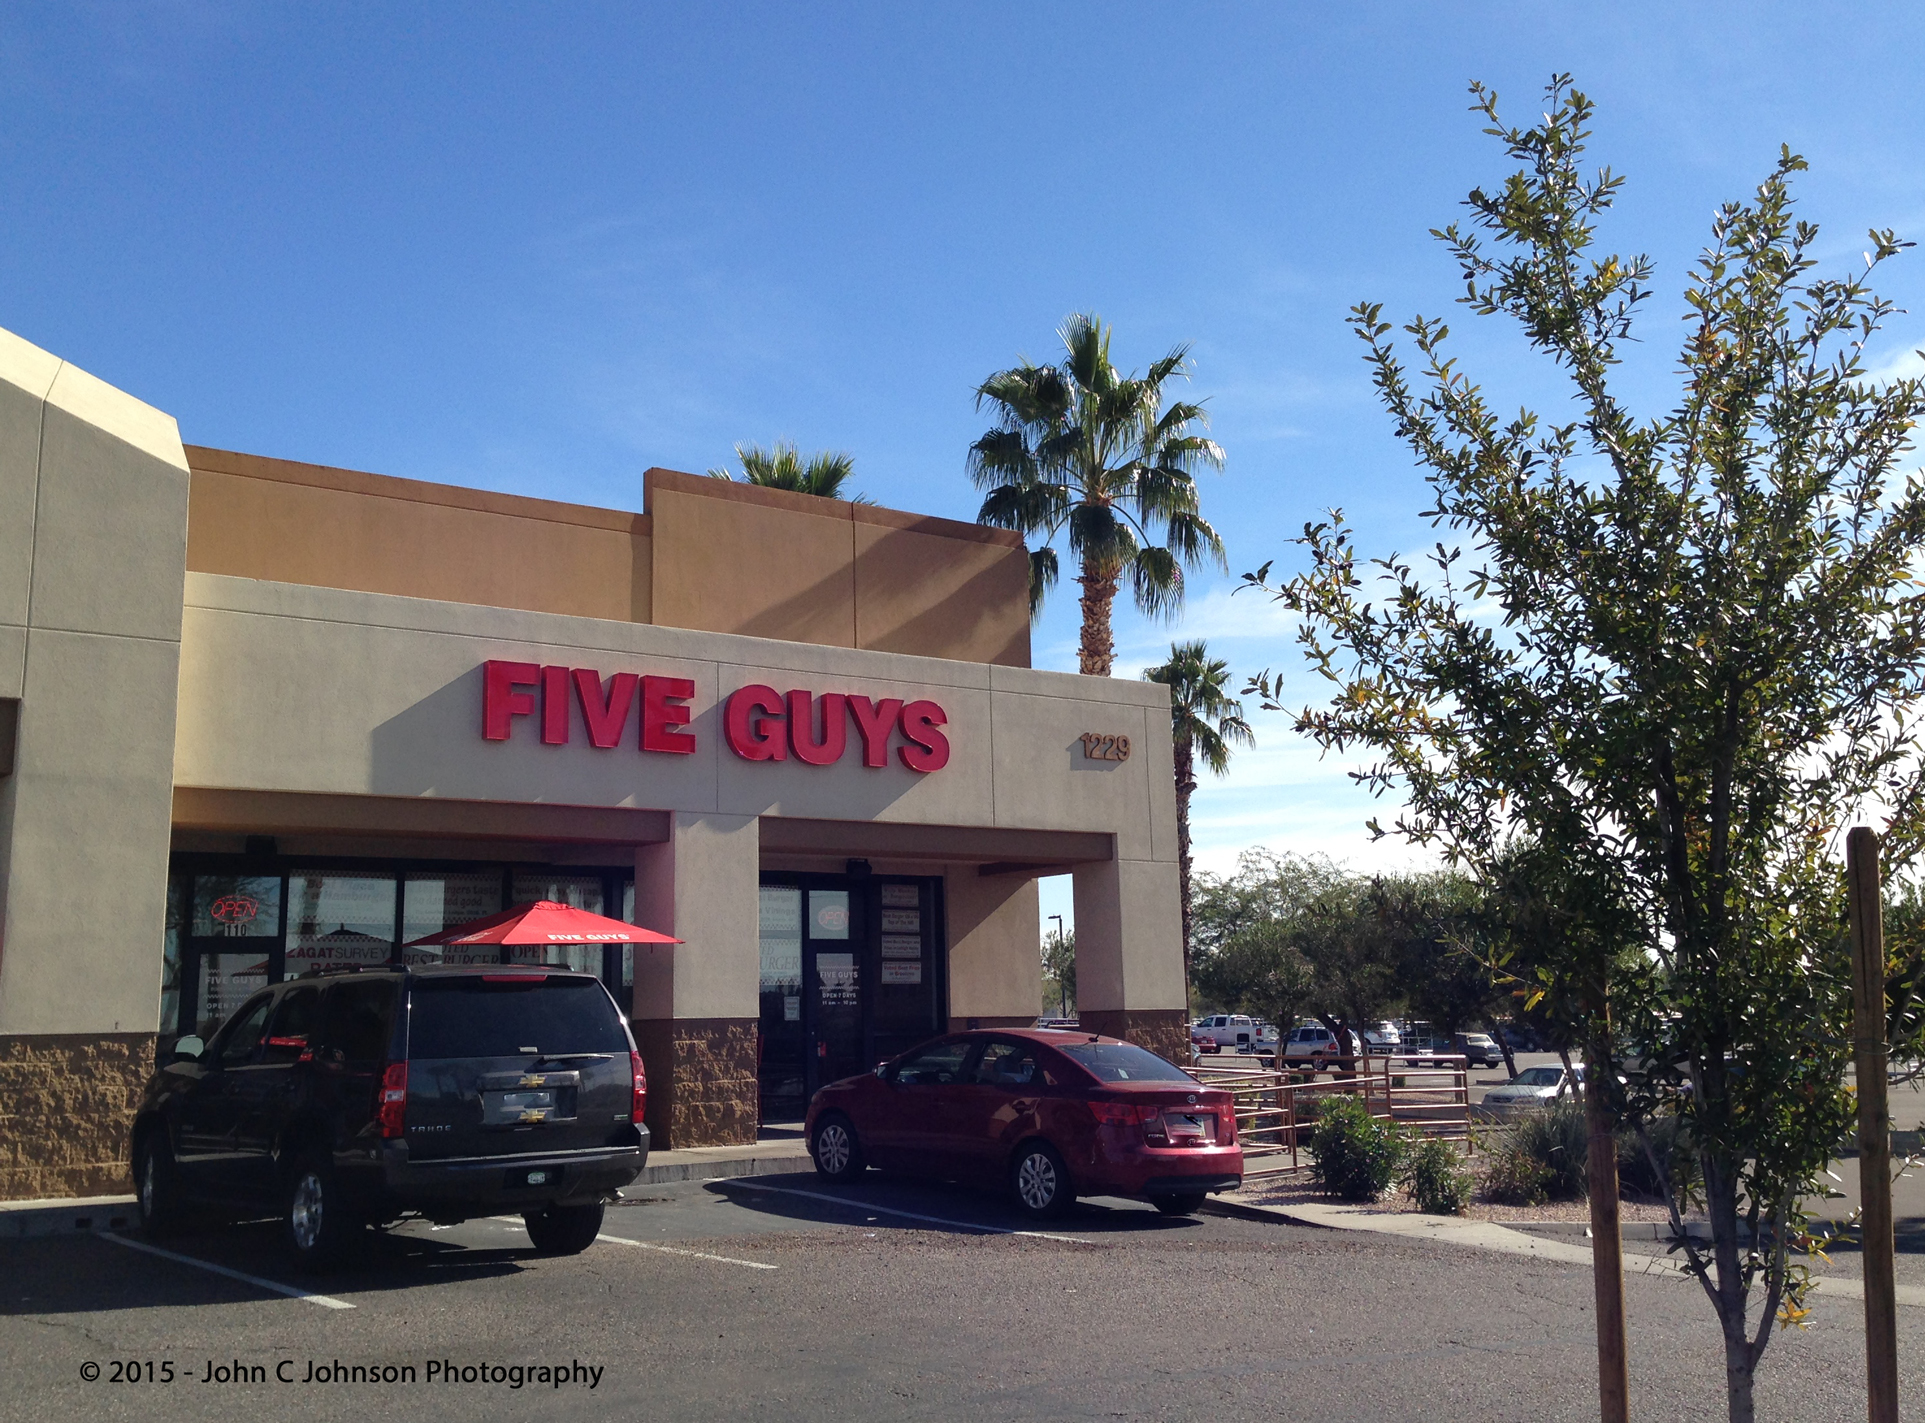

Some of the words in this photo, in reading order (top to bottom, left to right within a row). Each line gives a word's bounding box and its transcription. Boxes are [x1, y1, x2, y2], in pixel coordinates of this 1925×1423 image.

[482, 660, 696, 755] FIVE
[723, 684, 950, 773] GUYS
[1080, 732, 1131, 761] 1229
[460, 896, 482, 908] good
[211, 900, 258, 918] OPEN
[226, 924, 247, 936] 110
[760, 956, 800, 970] URGER
[205, 976, 229, 985] FIVE
[232, 976, 262, 985] GUYS
[410, 1124, 452, 1133] TAHOE
